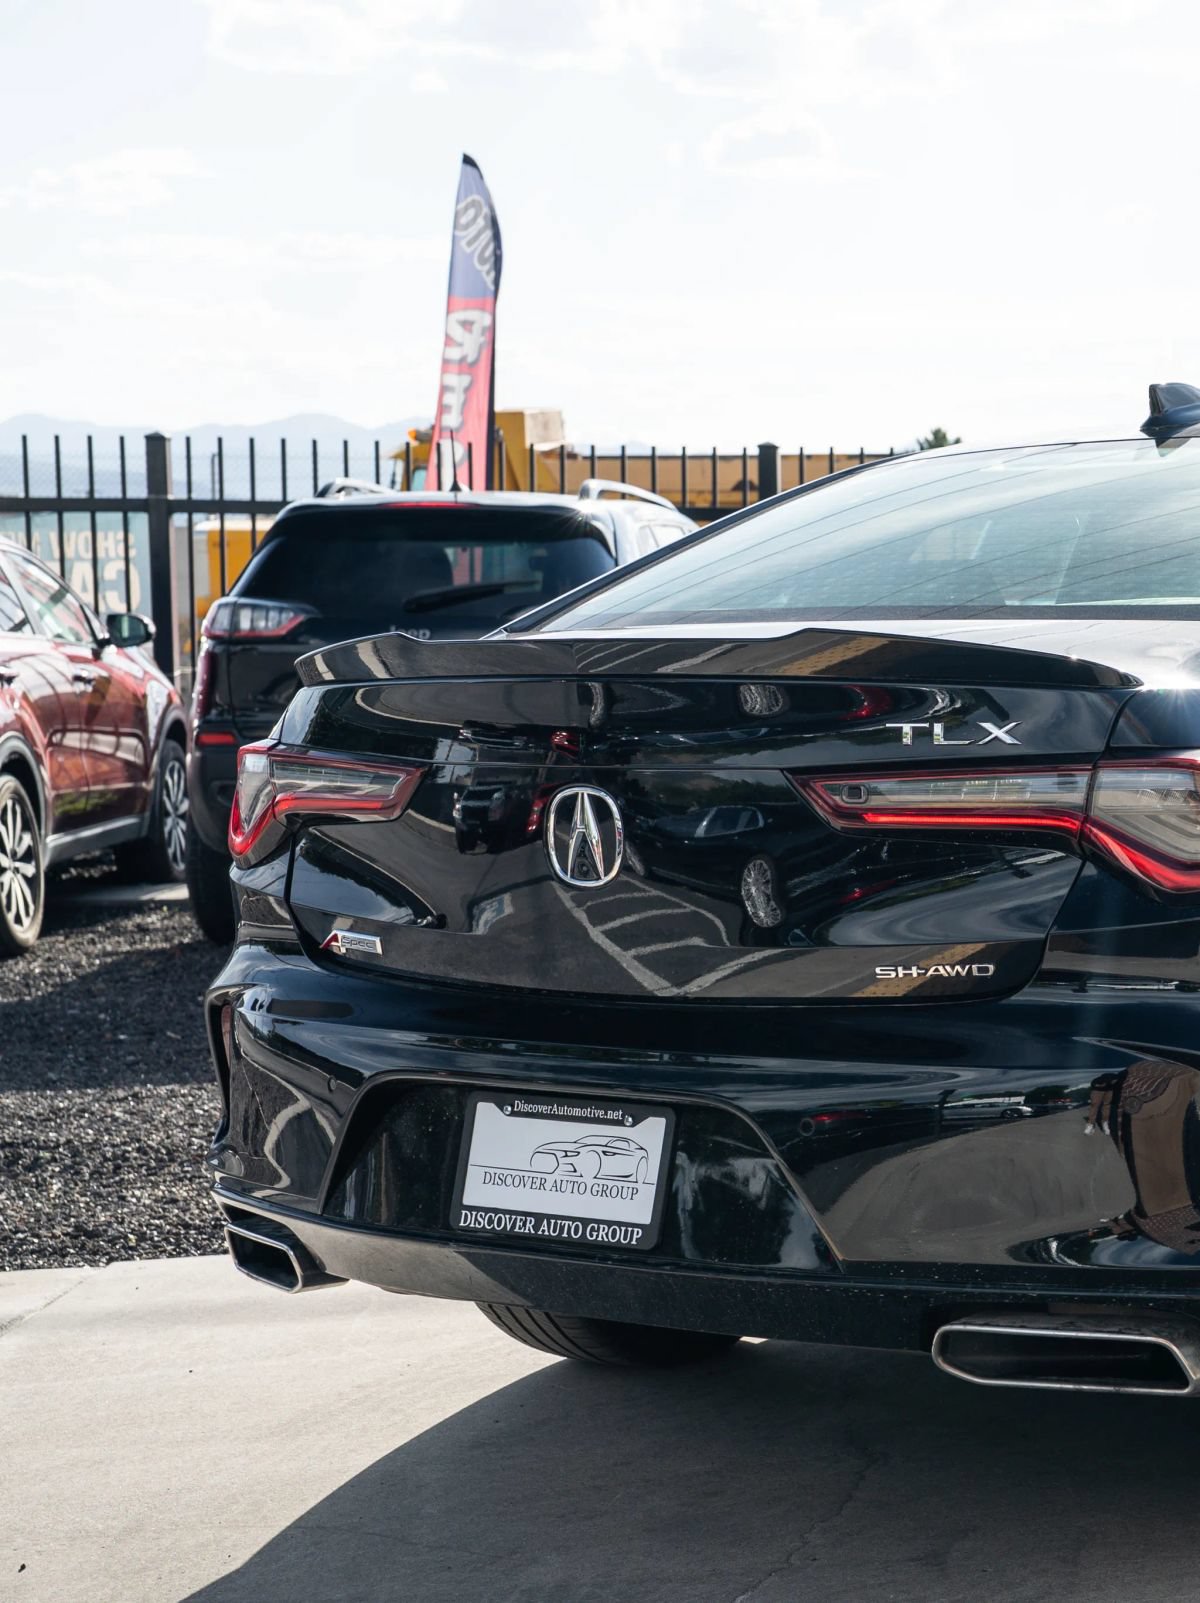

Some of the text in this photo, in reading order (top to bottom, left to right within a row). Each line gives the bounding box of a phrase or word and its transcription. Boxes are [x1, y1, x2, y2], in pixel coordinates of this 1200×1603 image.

[886, 721, 1023, 746] TLX
[875, 964, 995, 979] SH-AWD
[513, 1100, 623, 1120] DiscoverAutomotive.net
[482, 1171, 640, 1201] DISCOVER AUTO GROUP
[459, 1210, 643, 1245] DISCOVER AUTO GROUP
